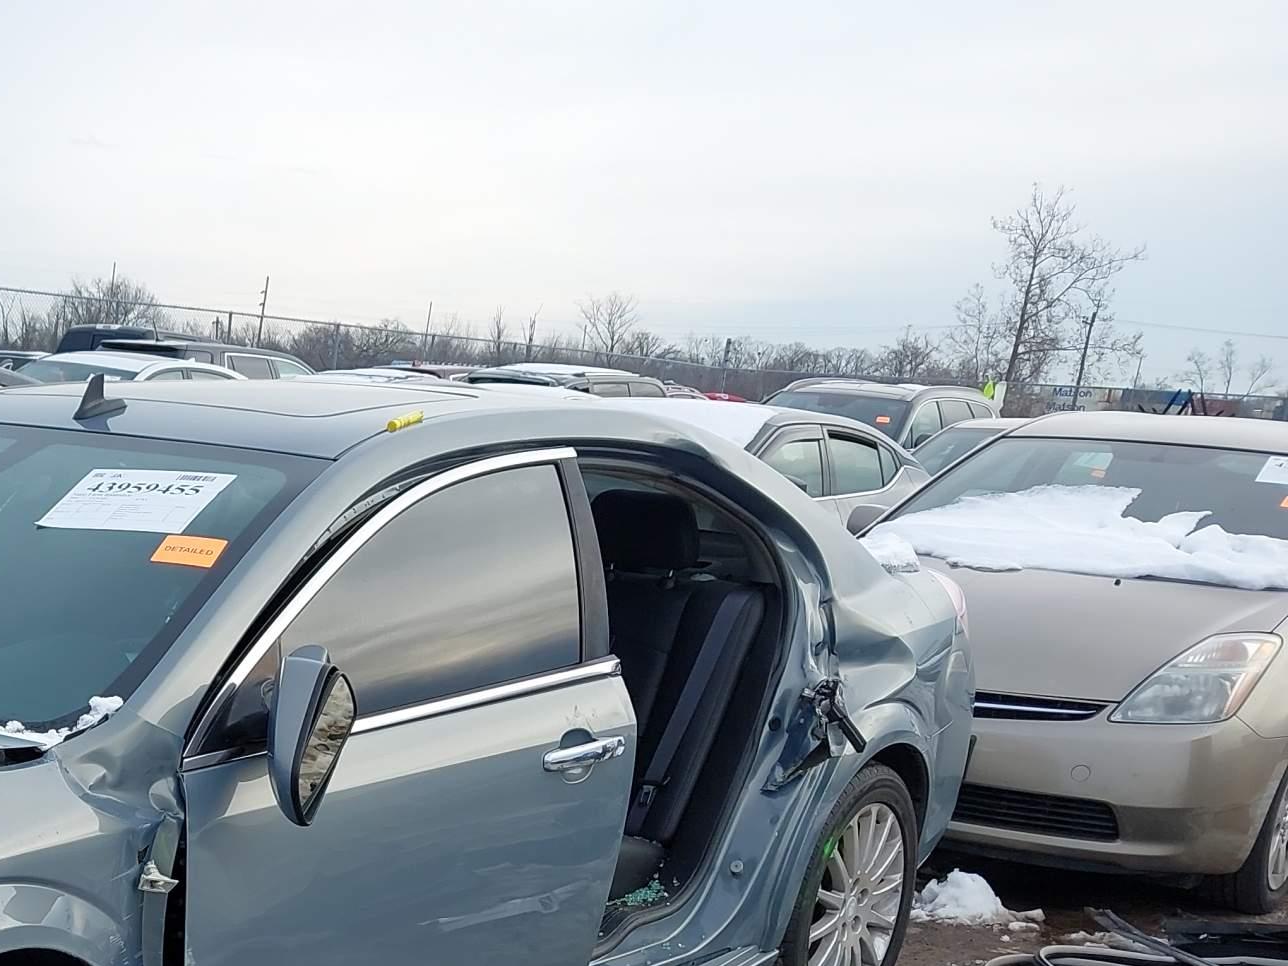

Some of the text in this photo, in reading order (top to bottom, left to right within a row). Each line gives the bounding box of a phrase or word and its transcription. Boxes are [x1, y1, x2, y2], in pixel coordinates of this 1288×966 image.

[1052, 387, 1093, 398] Maton
[87, 481, 204, 496] 43959455
[164, 544, 214, 557] DETAILED
